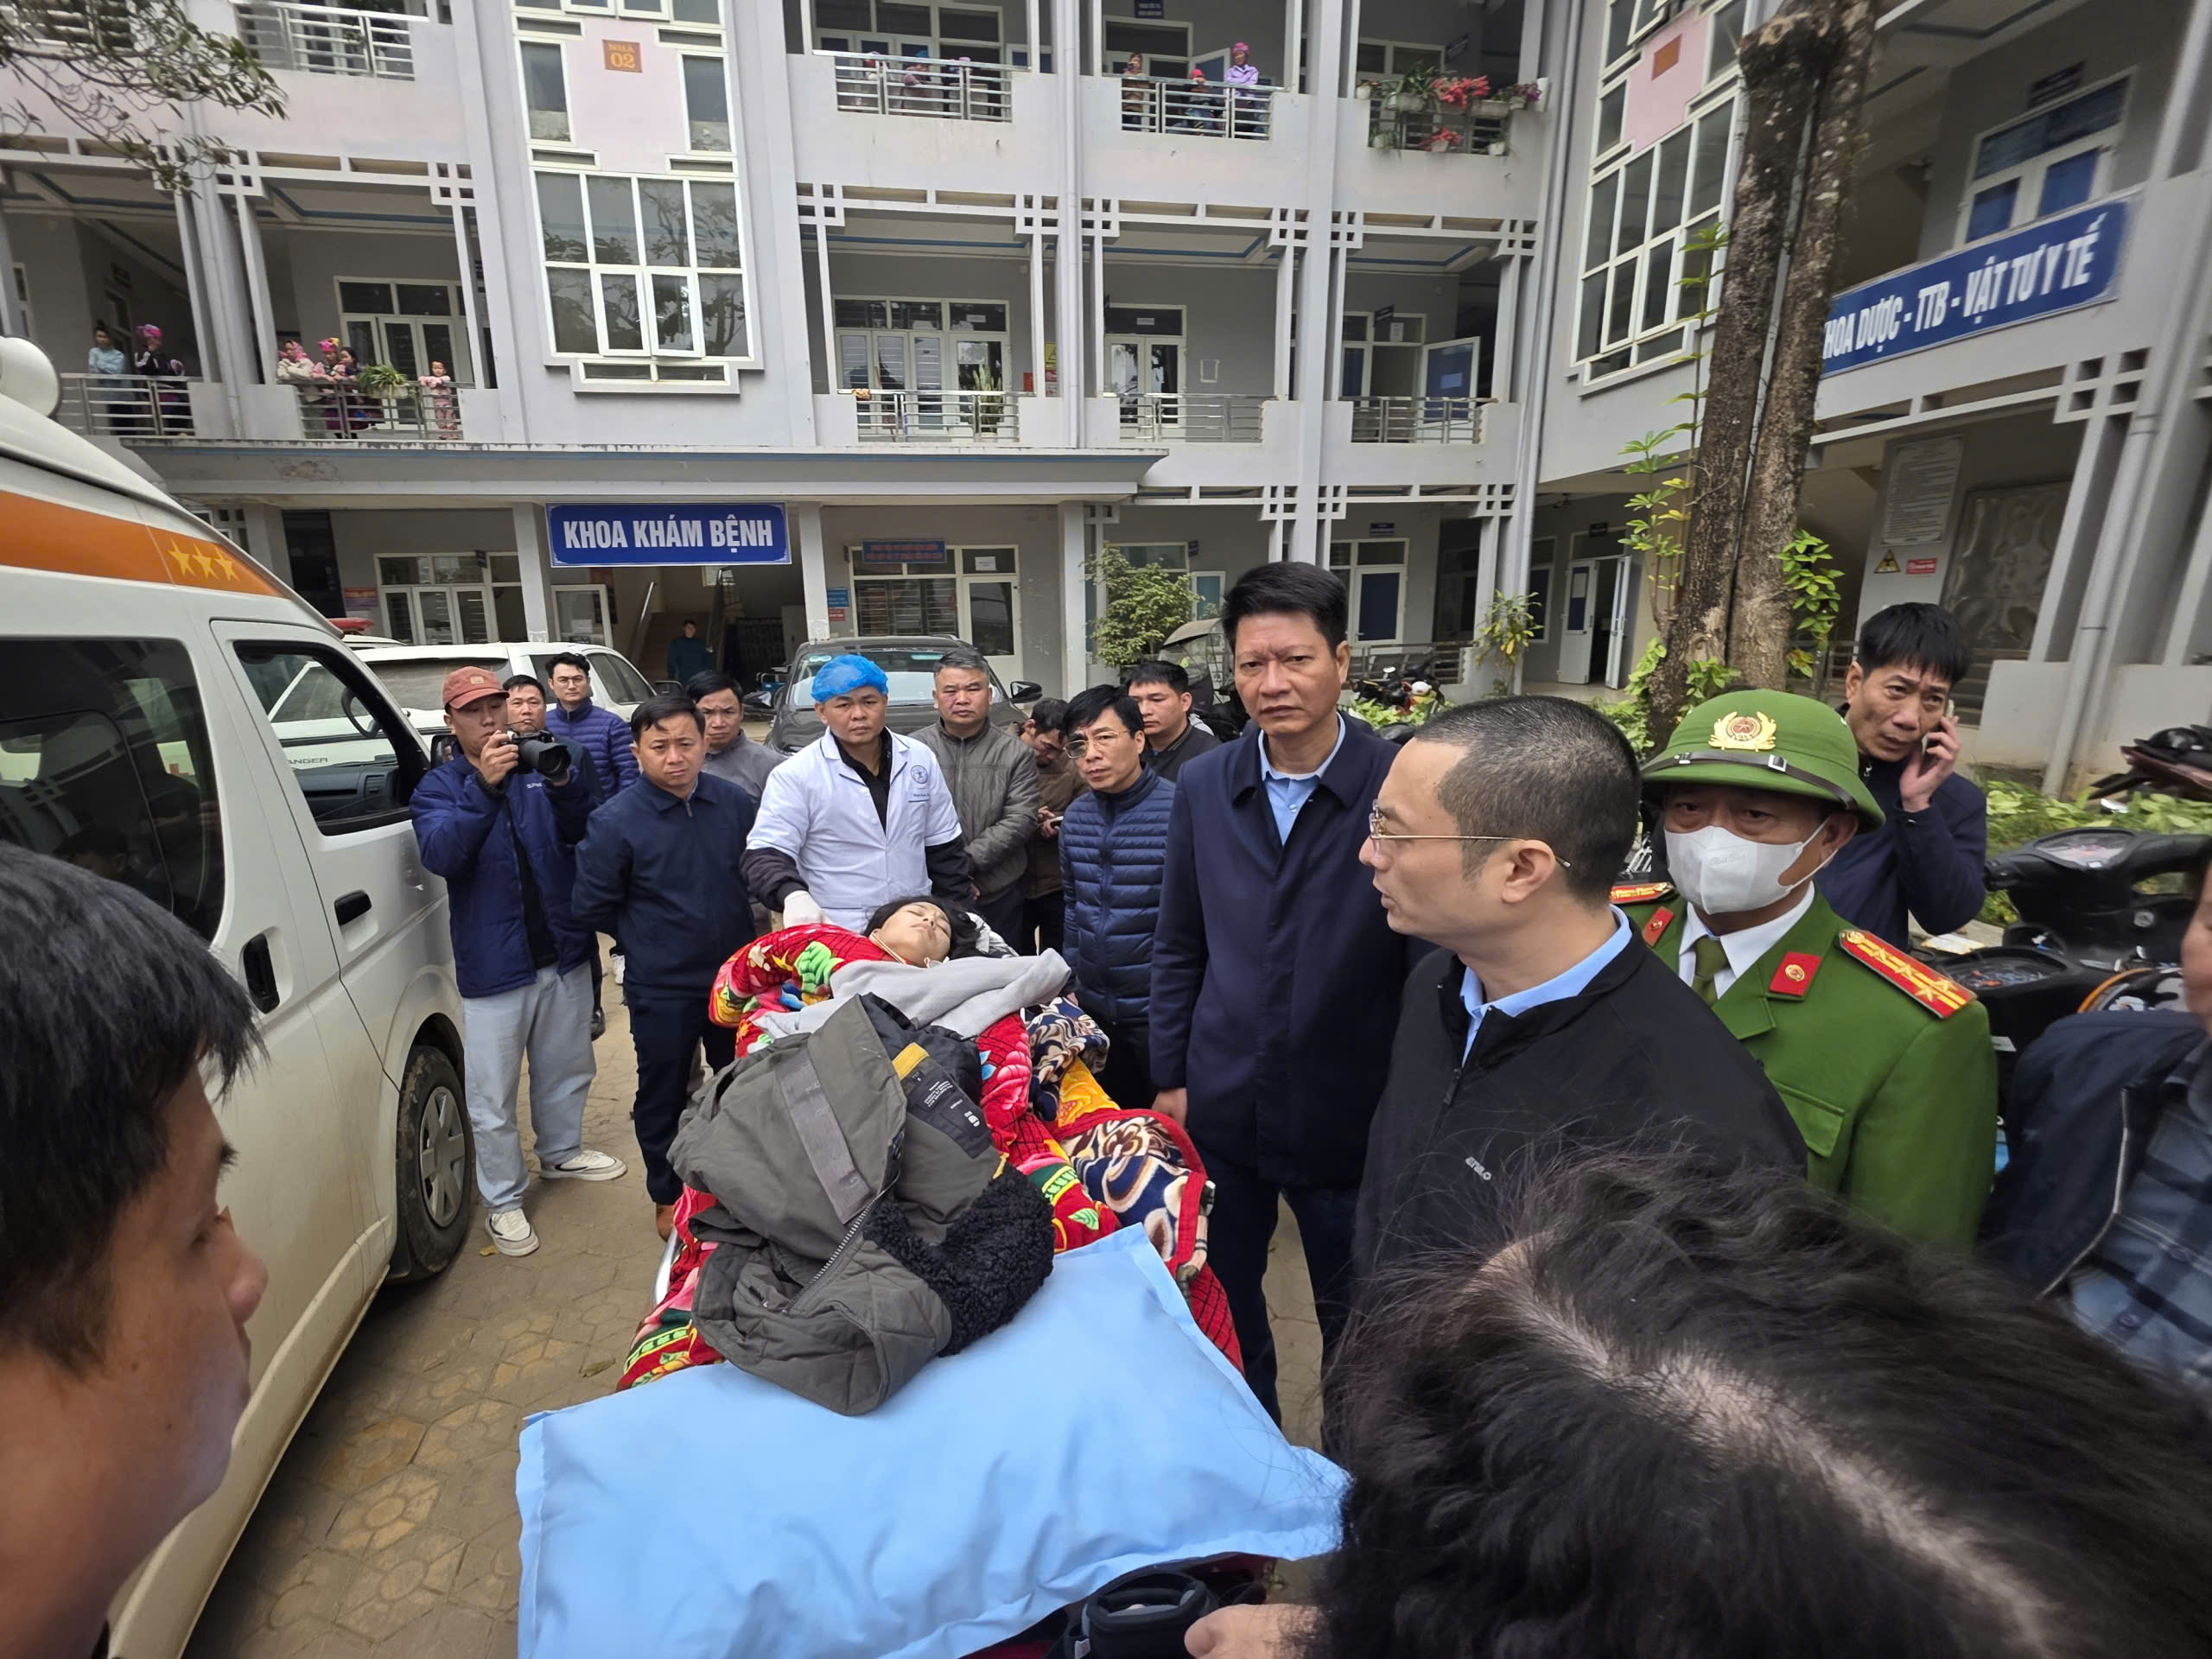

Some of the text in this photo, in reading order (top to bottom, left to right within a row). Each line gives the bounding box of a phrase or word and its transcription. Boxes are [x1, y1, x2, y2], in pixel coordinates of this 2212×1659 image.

[610, 53, 635, 68] 02
[1822, 313, 1856, 360] HOA
[1856, 295, 1904, 353] DƯỢC
[1914, 281, 1950, 333] TTB
[1963, 255, 2009, 325] VẬT
[2006, 243, 2050, 305] TƯ
[2041, 243, 2064, 296] Y
[2062, 212, 2108, 289] TẾ
[563, 514, 773, 553] KHOA KHÁM BỆNH
